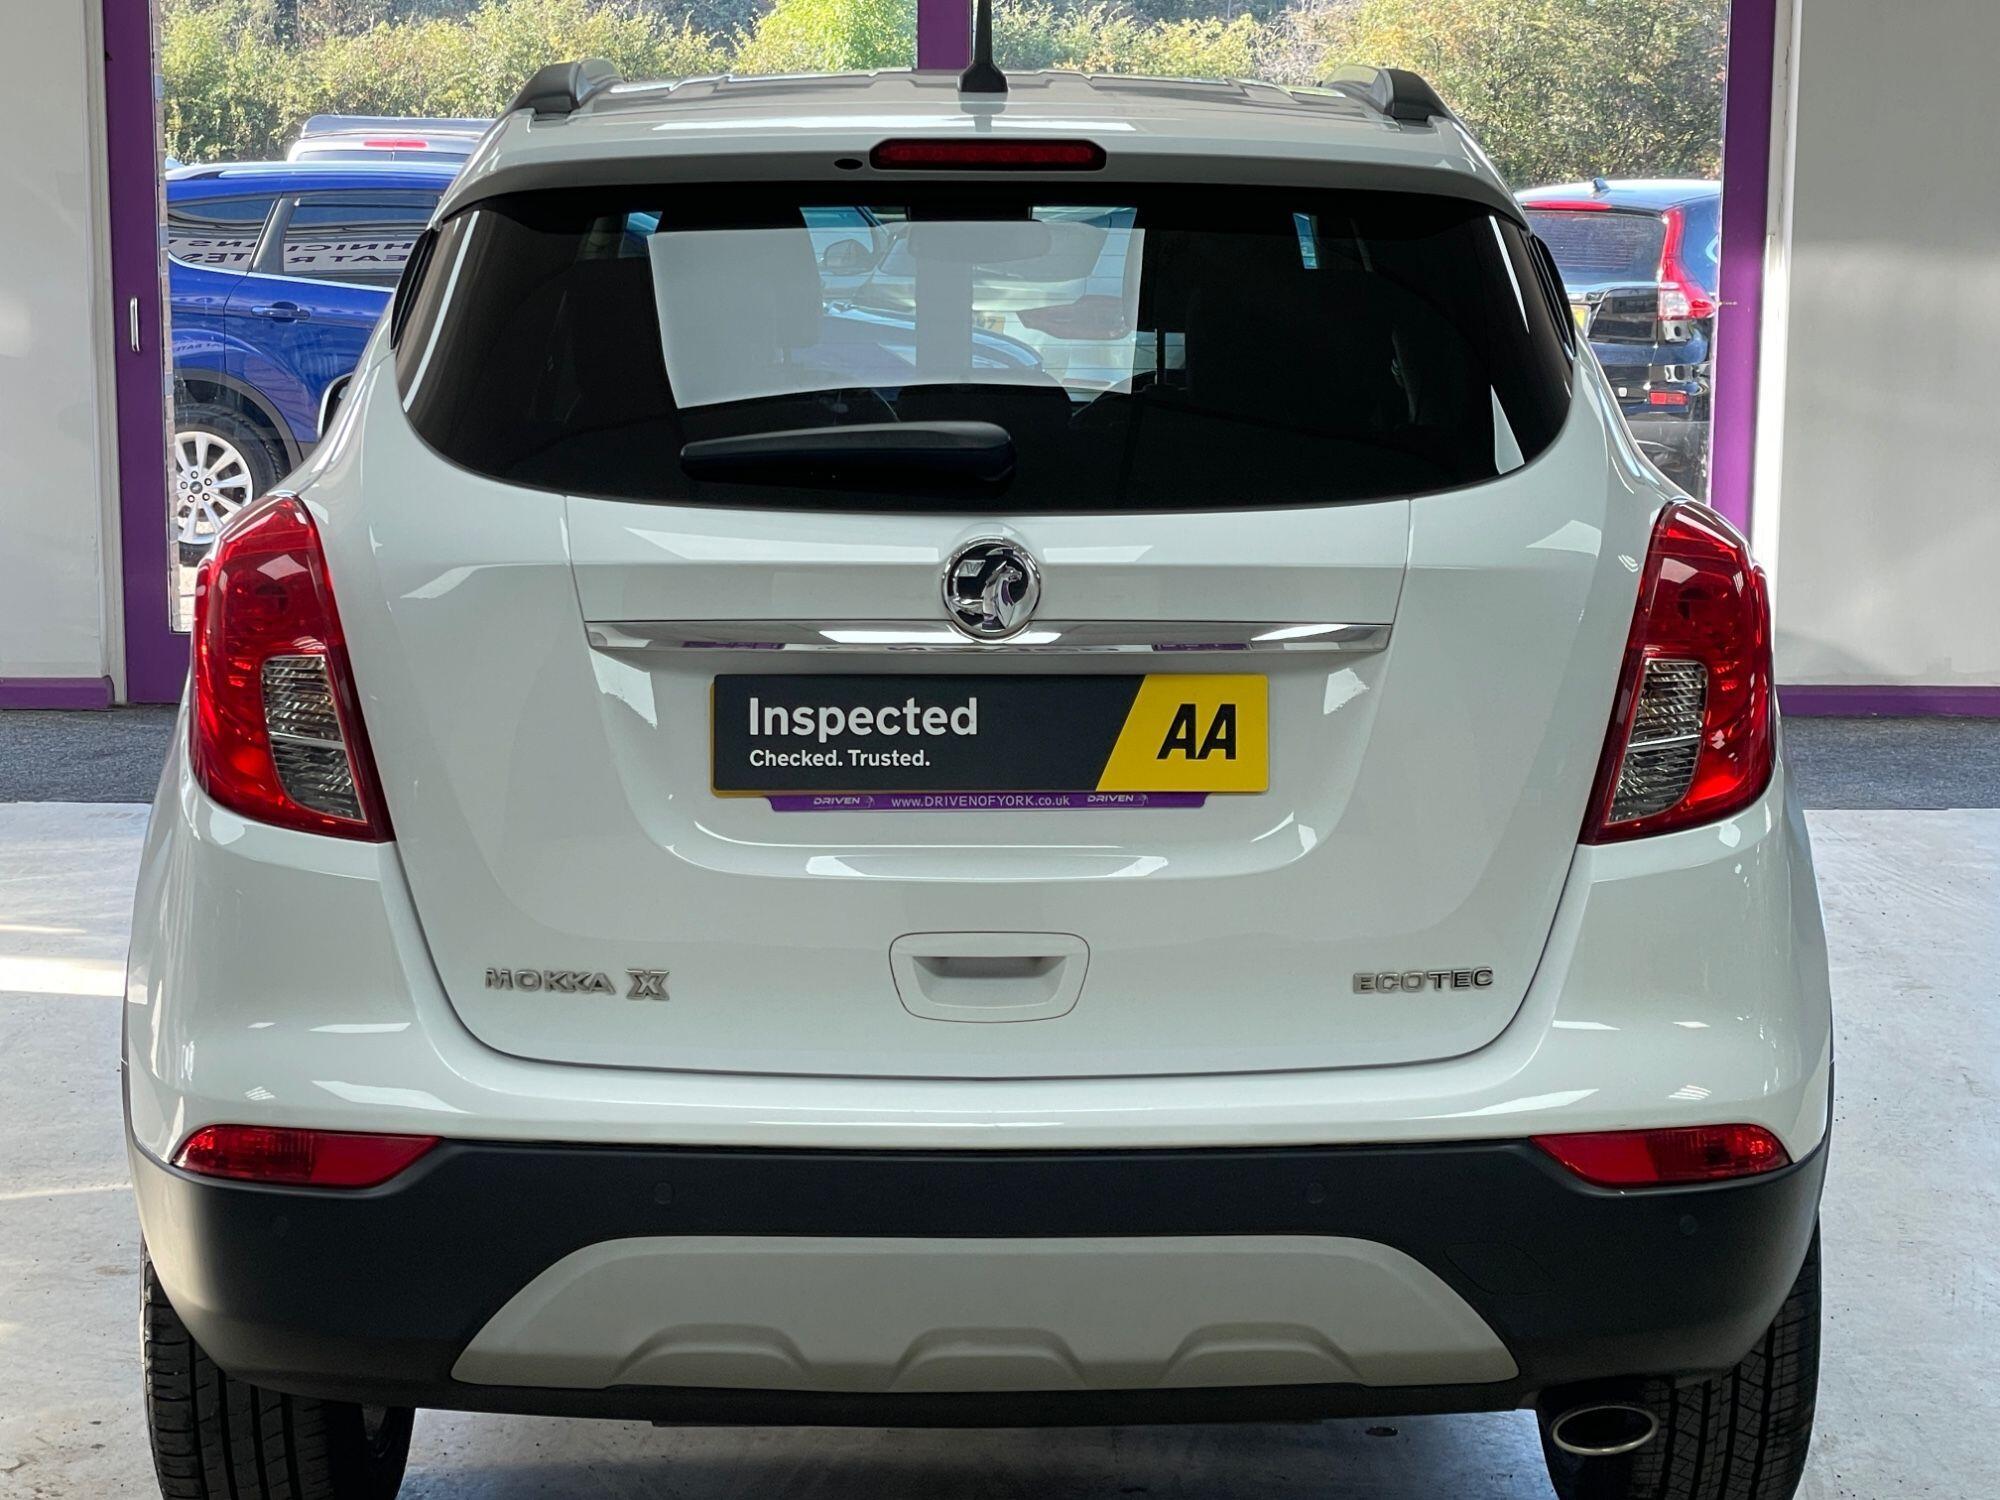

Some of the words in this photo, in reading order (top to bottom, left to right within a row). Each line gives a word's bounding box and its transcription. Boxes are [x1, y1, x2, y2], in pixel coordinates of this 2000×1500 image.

[750, 697, 978, 743] Inspected
[1156, 703, 1236, 760] AA
[750, 750, 843, 767] Checked.
[848, 750, 931, 767] Trusted.
[813, 796, 861, 805] DRIVEN
[891, 794, 1070, 807] www.DRIVENOFYORK.co.uk
[1087, 794, 1134, 803] DRIVEN
[485, 967, 617, 995] MOKKA
[625, 968, 670, 1000] X
[1353, 966, 1494, 994] ECOTEC
